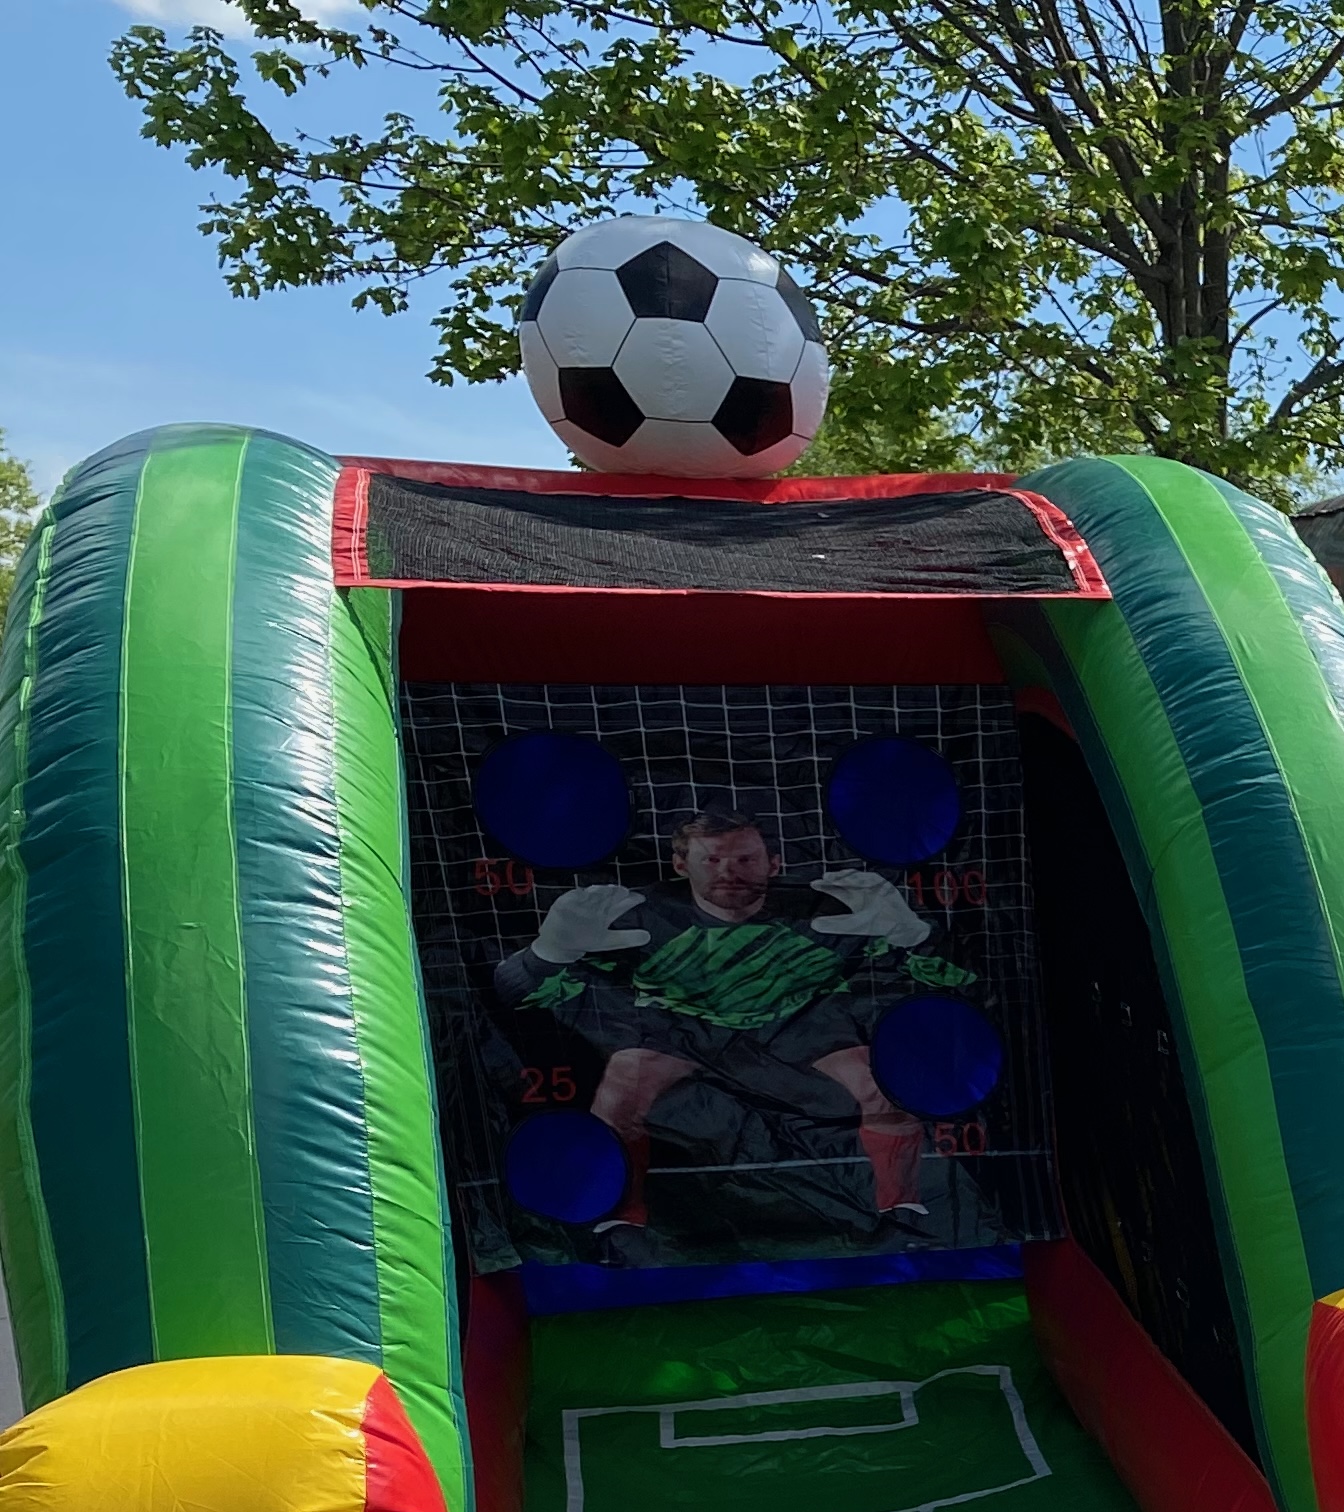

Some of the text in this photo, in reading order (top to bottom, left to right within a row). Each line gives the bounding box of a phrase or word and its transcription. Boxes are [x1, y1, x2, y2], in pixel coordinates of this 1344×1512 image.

[473, 858, 534, 896] 50
[907, 870, 987, 907] 100
[519, 1065, 577, 1104] 25
[934, 1121, 986, 1156] 50
